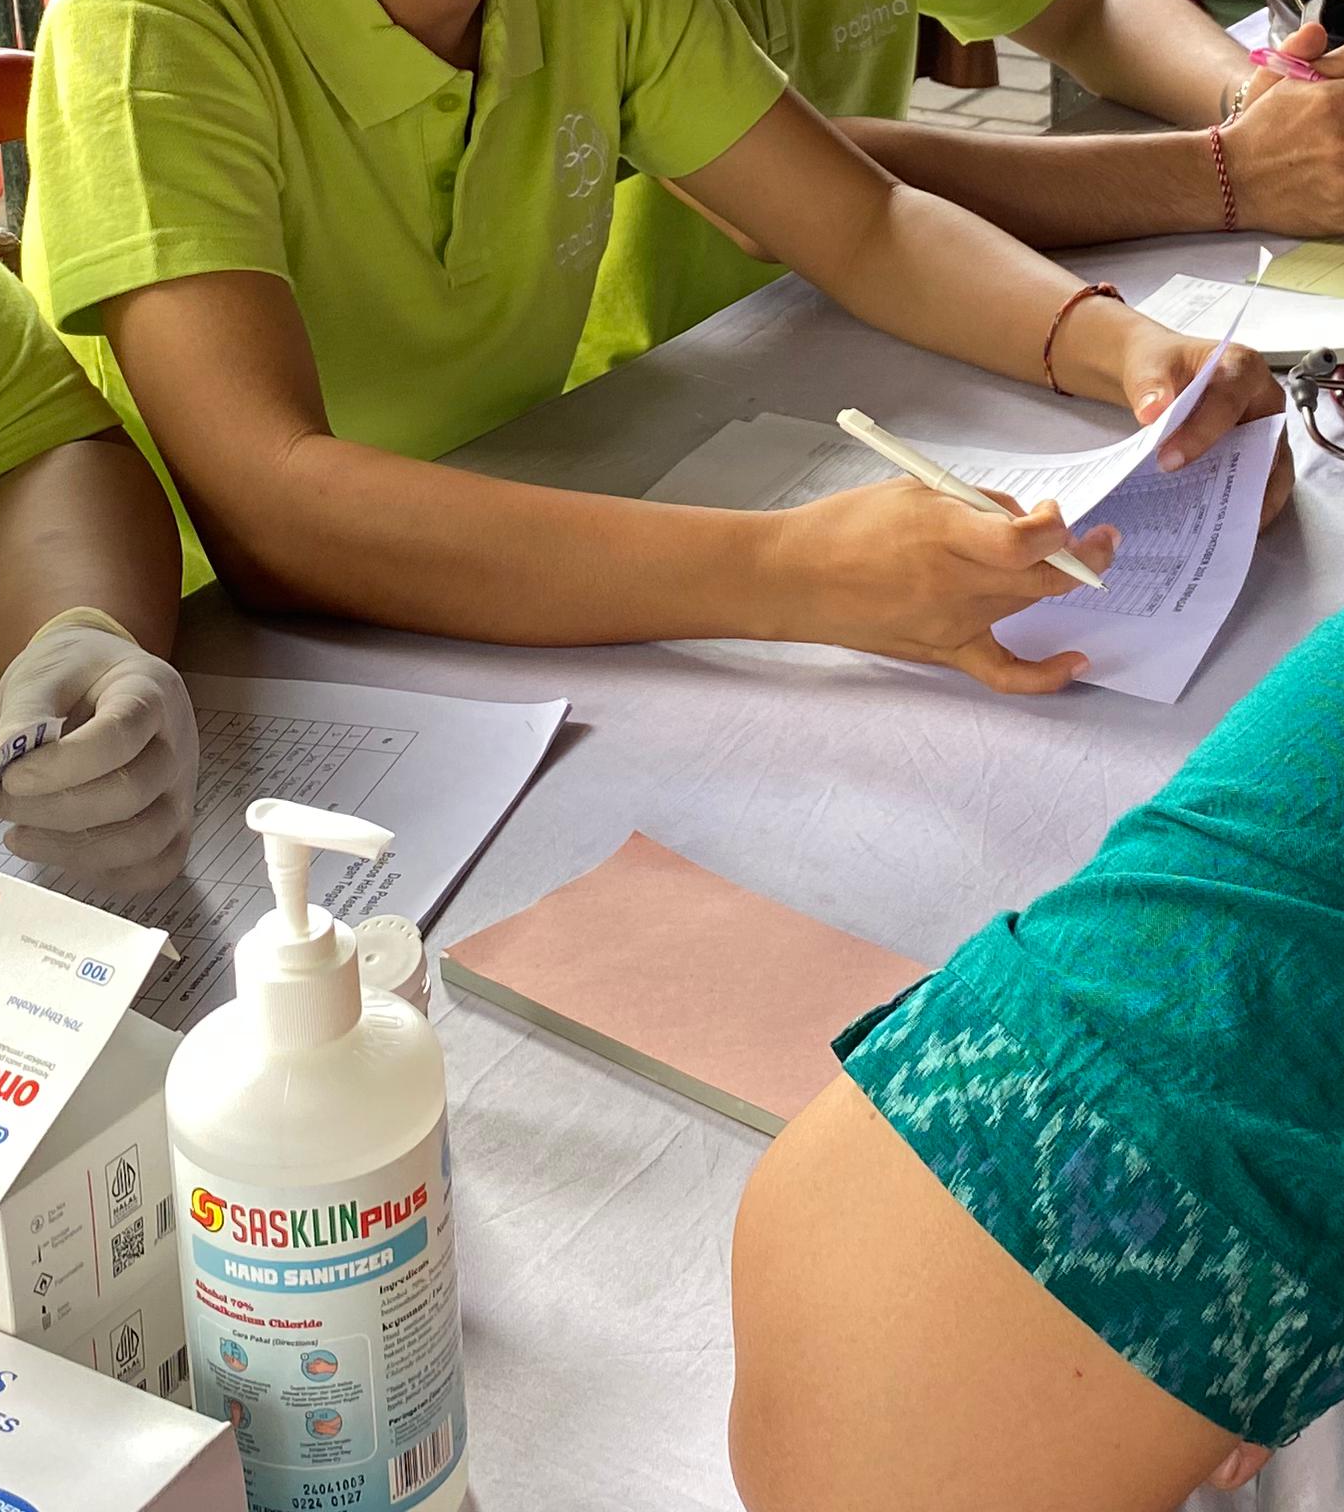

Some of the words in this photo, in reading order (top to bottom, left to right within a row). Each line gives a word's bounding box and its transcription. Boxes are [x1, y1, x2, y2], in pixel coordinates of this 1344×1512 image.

[81, 962, 108, 982] 100
[7, 995, 41, 1016] Alcohol
[40, 1004, 64, 1026] Ethyl
[64, 1013, 83, 1032] 70%
[113, 1195, 137, 1215] HALAL
[224, 1259, 278, 1285] HAND
[284, 1248, 394, 1286] SANITIZER
[196, 1290, 265, 1326] Benzalkonium
[268, 1318, 323, 1329] Chloride
[231, 1298, 254, 1311] 70%
[232, 1329, 249, 1340] Cara
[272, 1338, 319, 1347] (Directions)
[303, 1474, 365, 1496] 24041003
[292, 1496, 322, 1510] 0224
[331, 1490, 362, 1508] 0127
